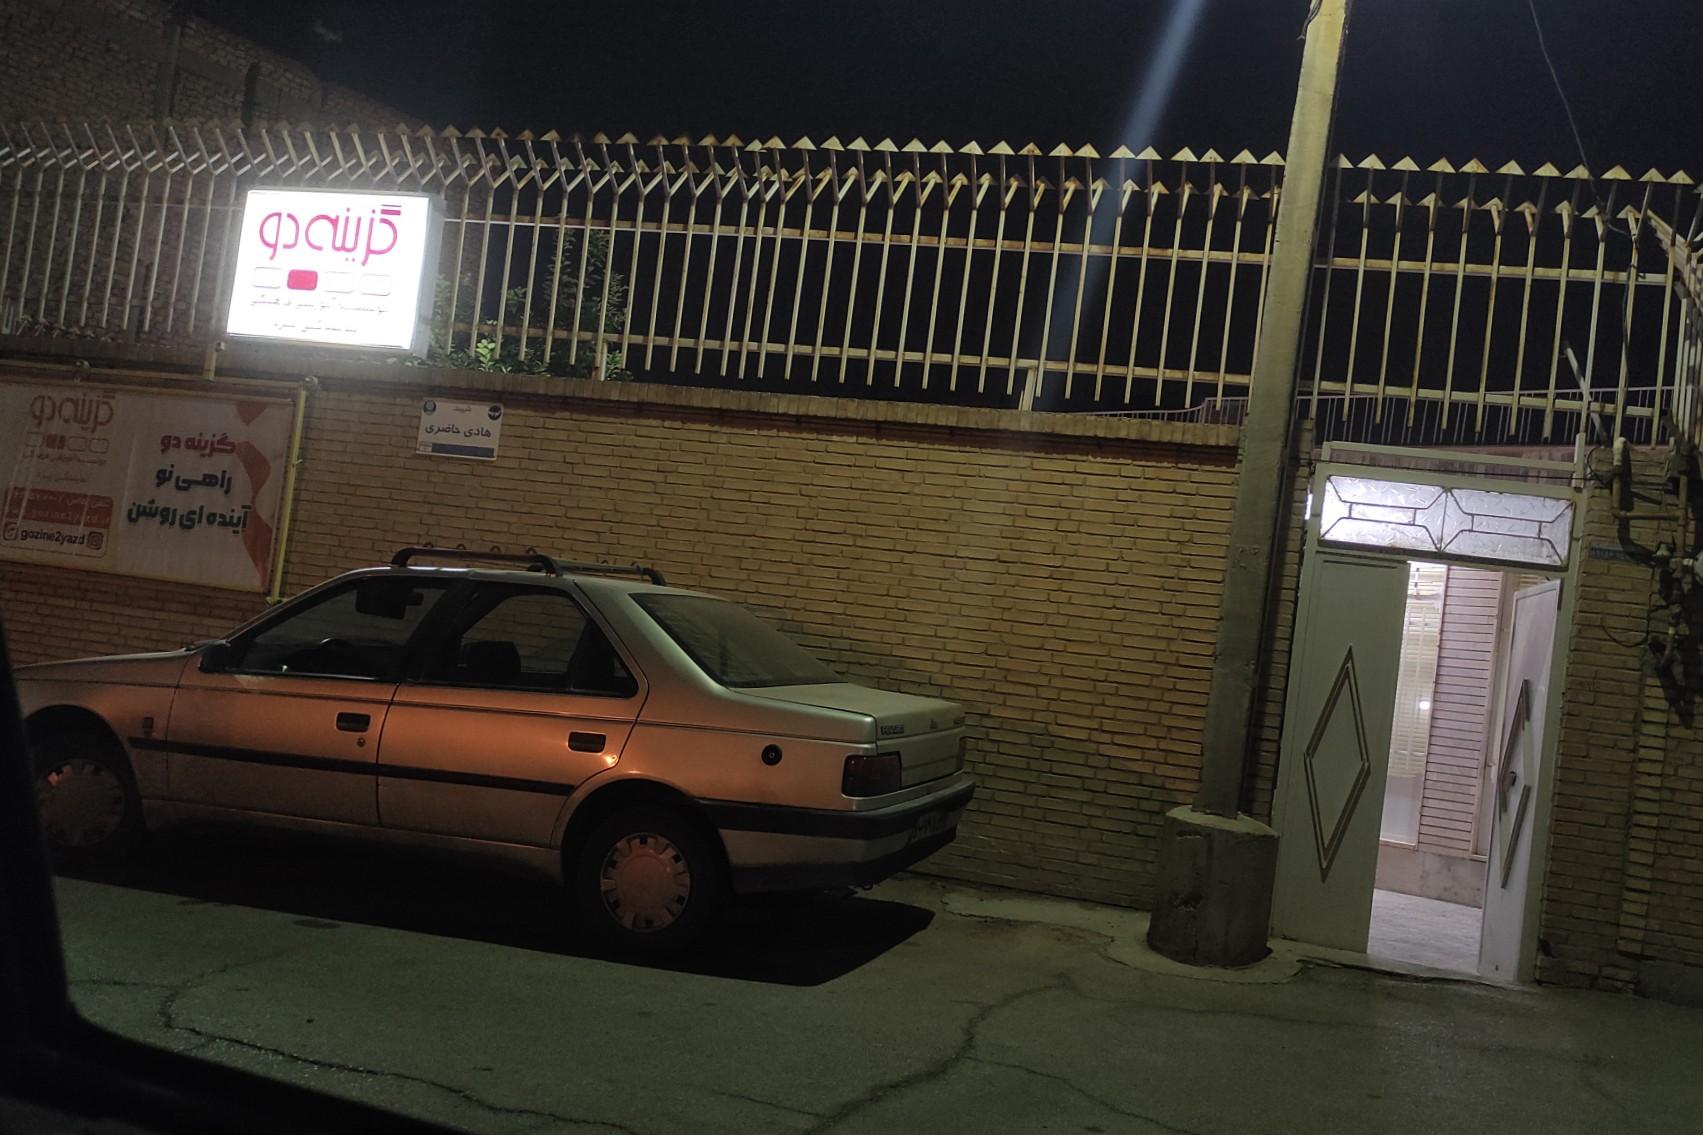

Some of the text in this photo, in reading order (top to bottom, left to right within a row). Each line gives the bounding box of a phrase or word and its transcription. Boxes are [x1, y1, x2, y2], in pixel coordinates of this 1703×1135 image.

[259, 204, 402, 266] گزینه دو
[31, 391, 116, 433] گزینه دو
[160, 432, 236, 457] گزینه دو
[425, 423, 492, 438] هادی حاضری
[155, 463, 232, 495] راهی نو
[127, 498, 177, 528] روشن
[179, 505, 204, 530] ای
[205, 504, 252, 535] آینده
[20, 527, 86, 546] gozine2yazd
